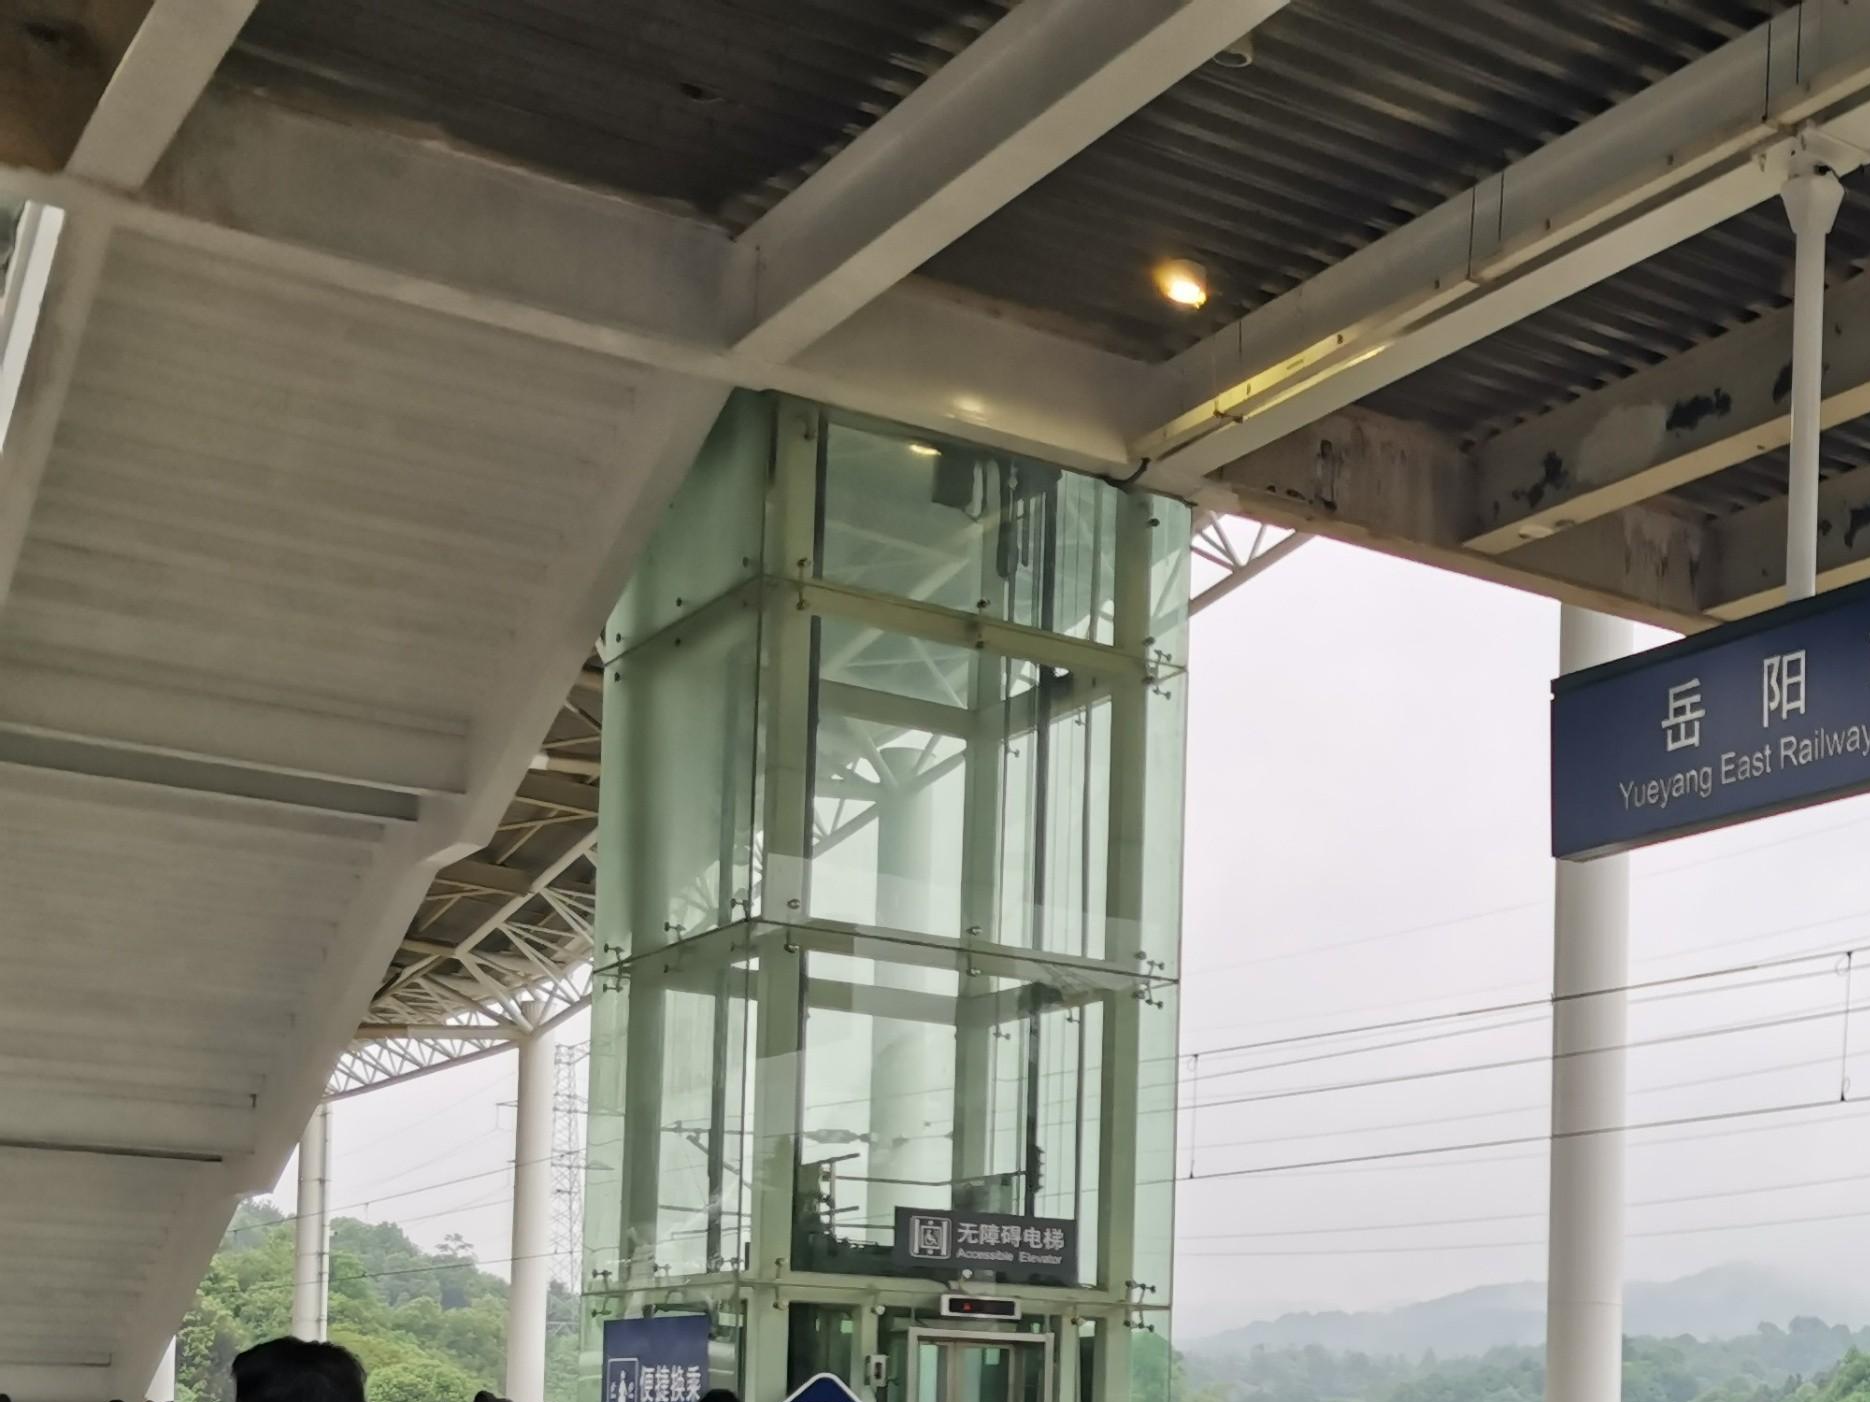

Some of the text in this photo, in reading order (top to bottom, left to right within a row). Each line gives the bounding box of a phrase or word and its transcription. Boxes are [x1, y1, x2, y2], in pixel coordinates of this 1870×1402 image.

[1619, 764, 1713, 811] Yueyang
[1720, 746, 1772, 785] East
[957, 1222, 1065, 1251] 无障碍电梯
[956, 1248, 1063, 1265] Accessible Elevator
[639, 1364, 702, 1402] 便捷换乘
